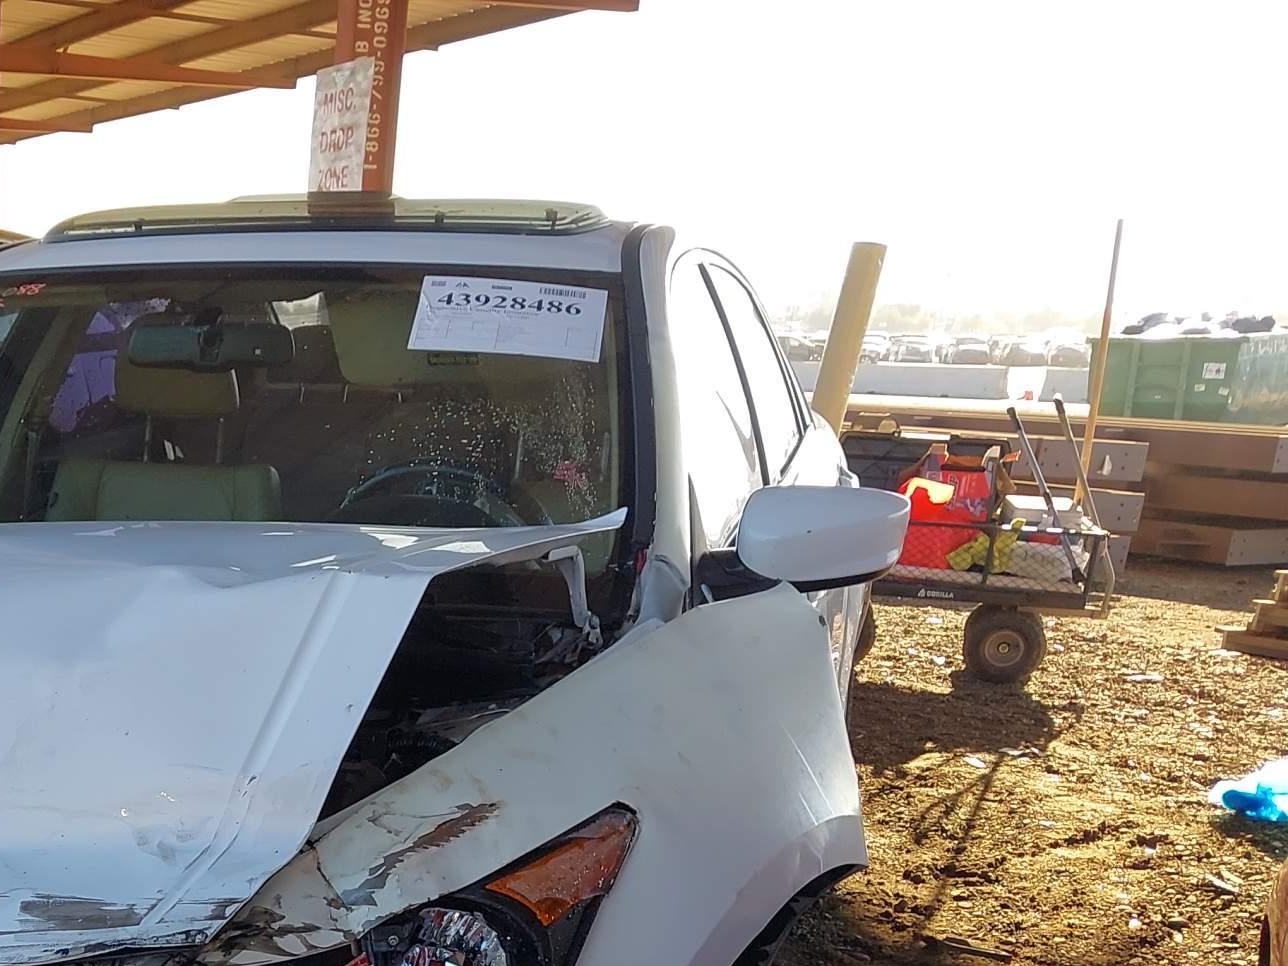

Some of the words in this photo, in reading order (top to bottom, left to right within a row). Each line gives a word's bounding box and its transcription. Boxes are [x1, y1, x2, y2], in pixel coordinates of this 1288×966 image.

[322, 86, 357, 113] MISC.
[319, 125, 354, 153] DROP
[317, 165, 350, 192] ZONE
[437, 292, 582, 316] 43928486
